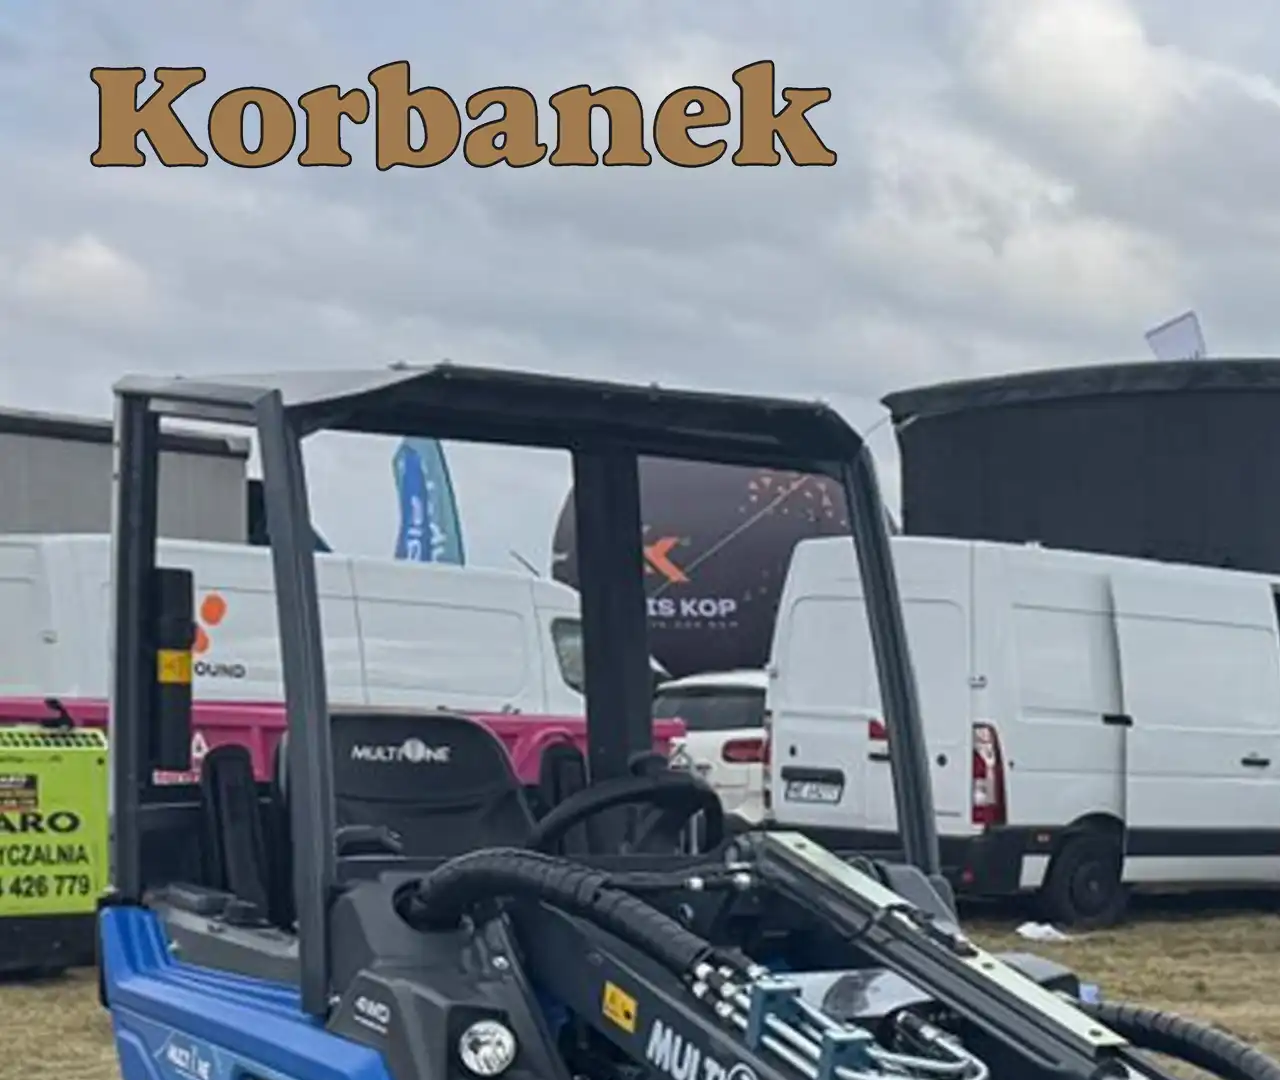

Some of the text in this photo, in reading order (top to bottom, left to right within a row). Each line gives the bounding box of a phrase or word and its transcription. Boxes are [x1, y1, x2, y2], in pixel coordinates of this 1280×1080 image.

[679, 597, 737, 617] KOP
[193, 661, 246, 679] OUND
[10, 874, 91, 897] 426 779
